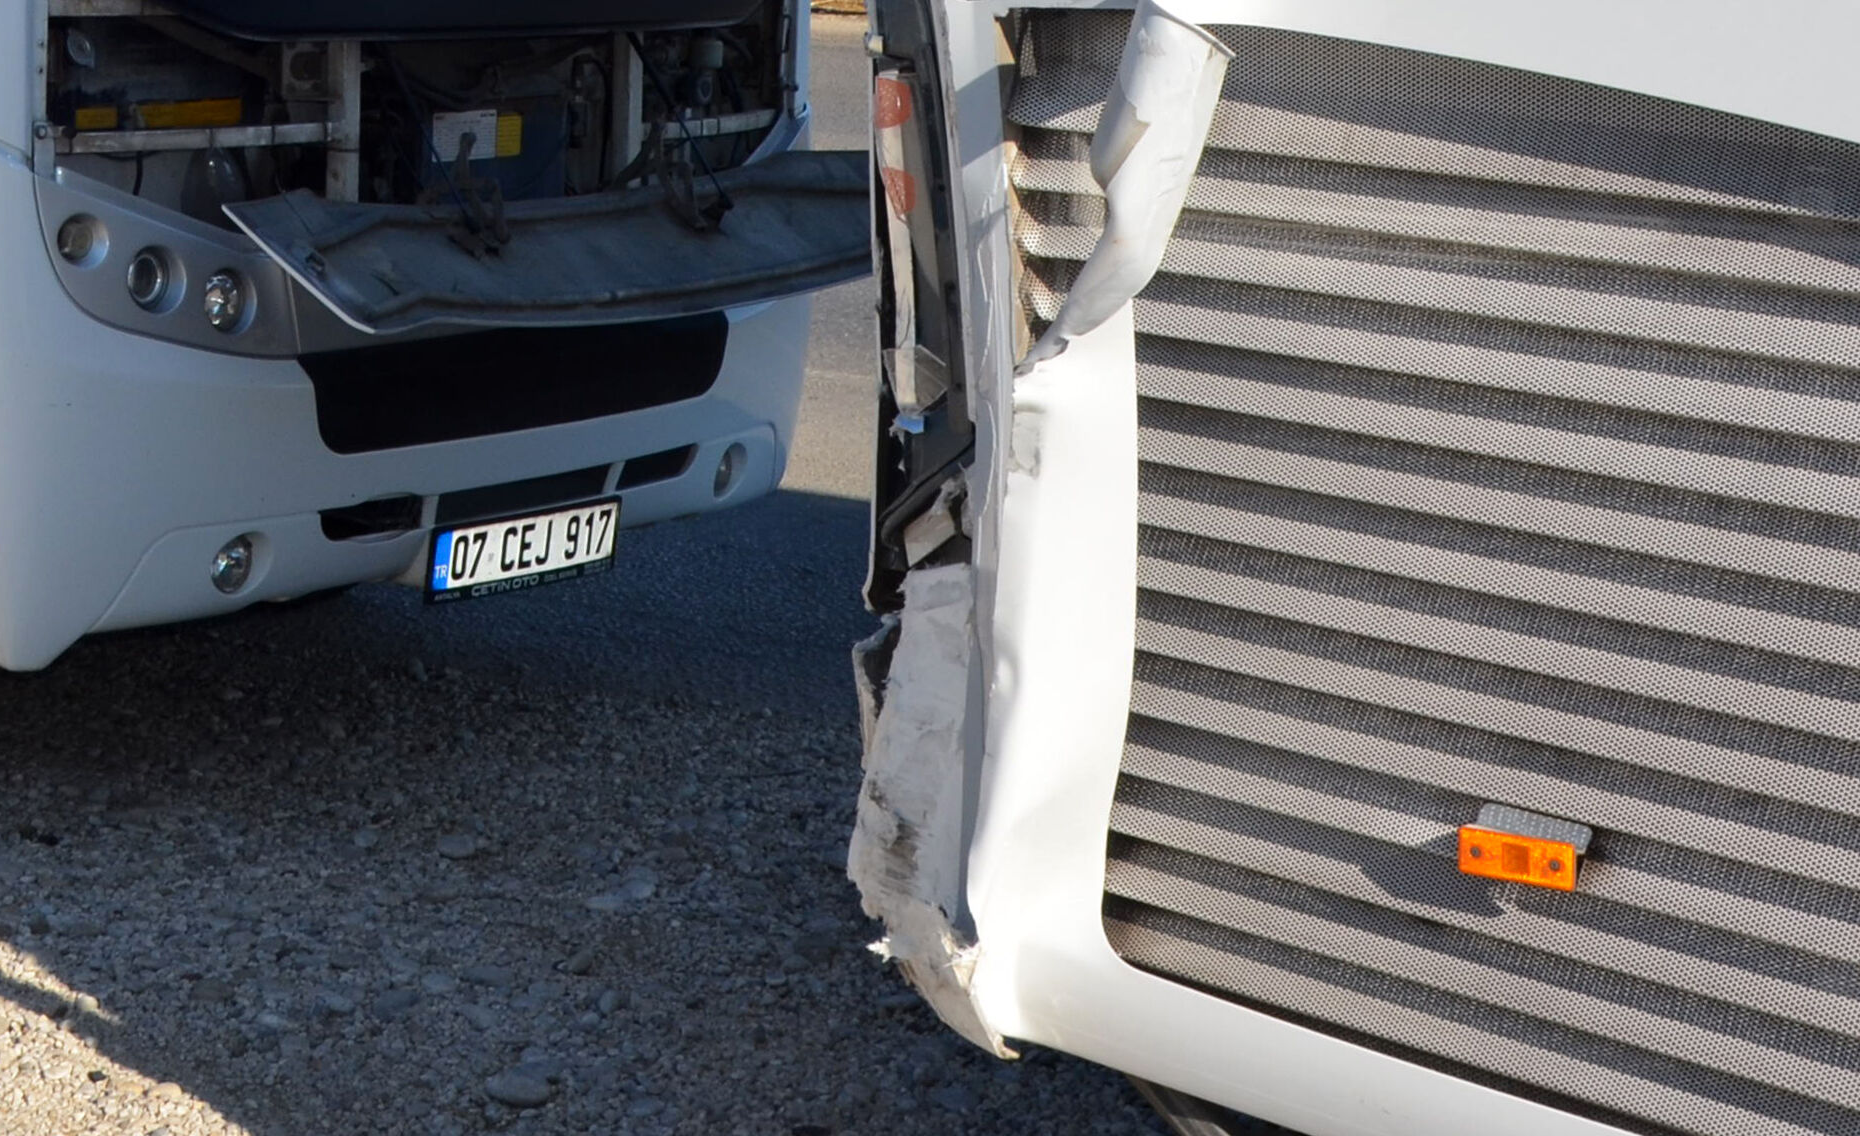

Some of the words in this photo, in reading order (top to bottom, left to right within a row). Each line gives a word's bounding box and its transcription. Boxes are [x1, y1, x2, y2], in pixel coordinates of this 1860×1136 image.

[451, 531, 488, 581] 07
[500, 519, 554, 573] CEJ
[564, 508, 613, 560] 917
[434, 565, 448, 580] TR
[512, 574, 540, 589] OTO
